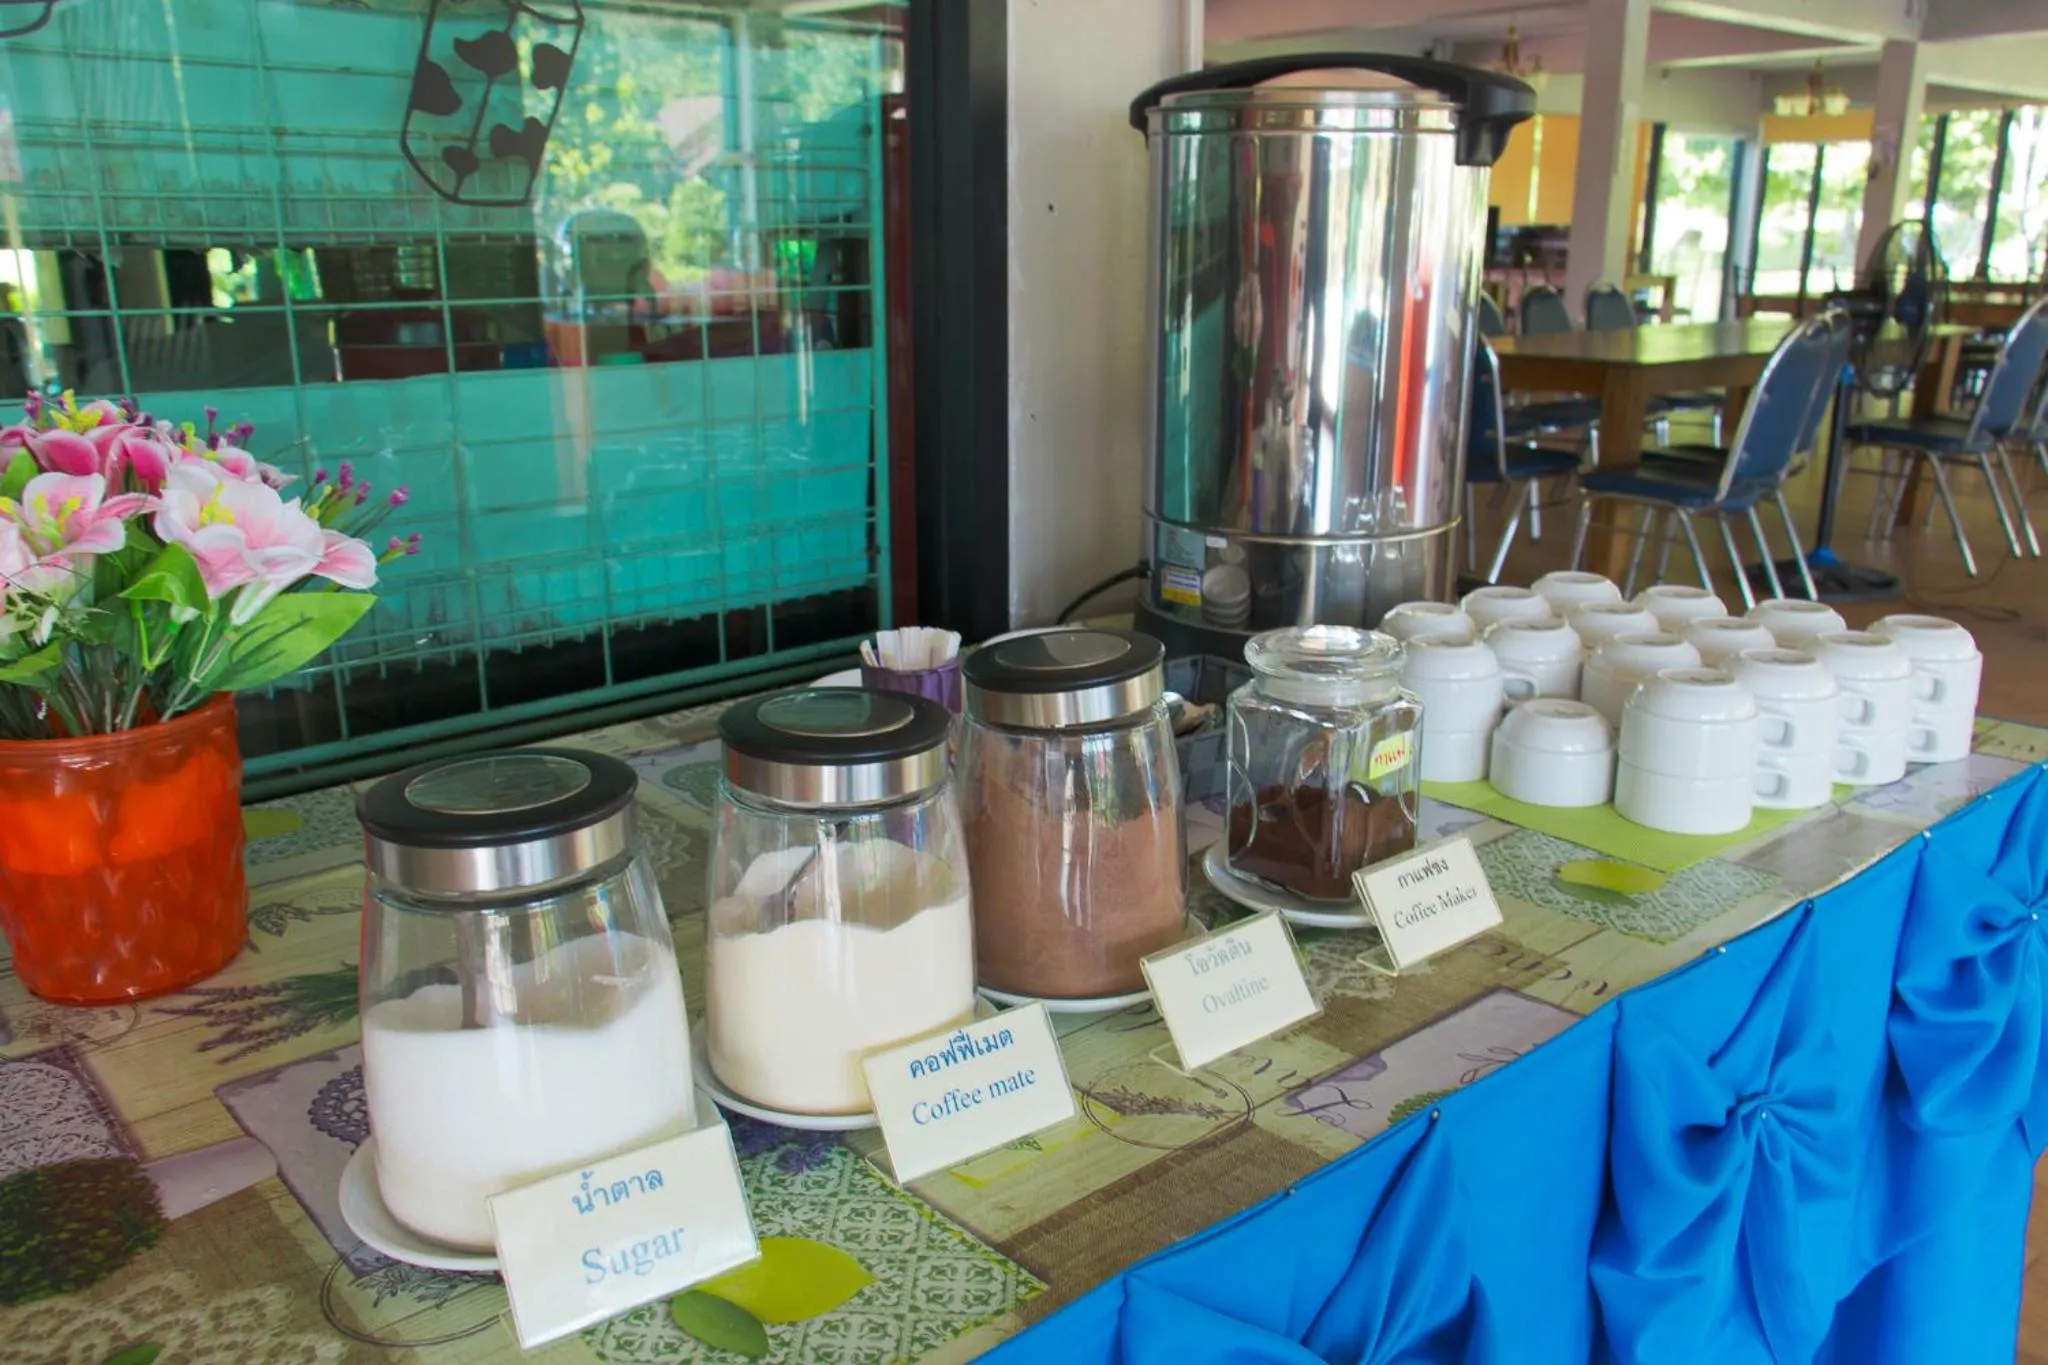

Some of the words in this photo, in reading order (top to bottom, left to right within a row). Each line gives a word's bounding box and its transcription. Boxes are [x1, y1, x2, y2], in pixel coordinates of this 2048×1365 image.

[1393, 900, 1438, 929] Coffee
[1437, 886, 1478, 910] Maker
[1202, 976, 1270, 1014] Ovaltine
[909, 1028, 1014, 1079] คอฟฟี่เมต
[912, 1088, 982, 1125] Coffee
[988, 1069, 1036, 1099] mate
[571, 1168, 664, 1215] น้ำตาล
[581, 1227, 686, 1285] Sugar
